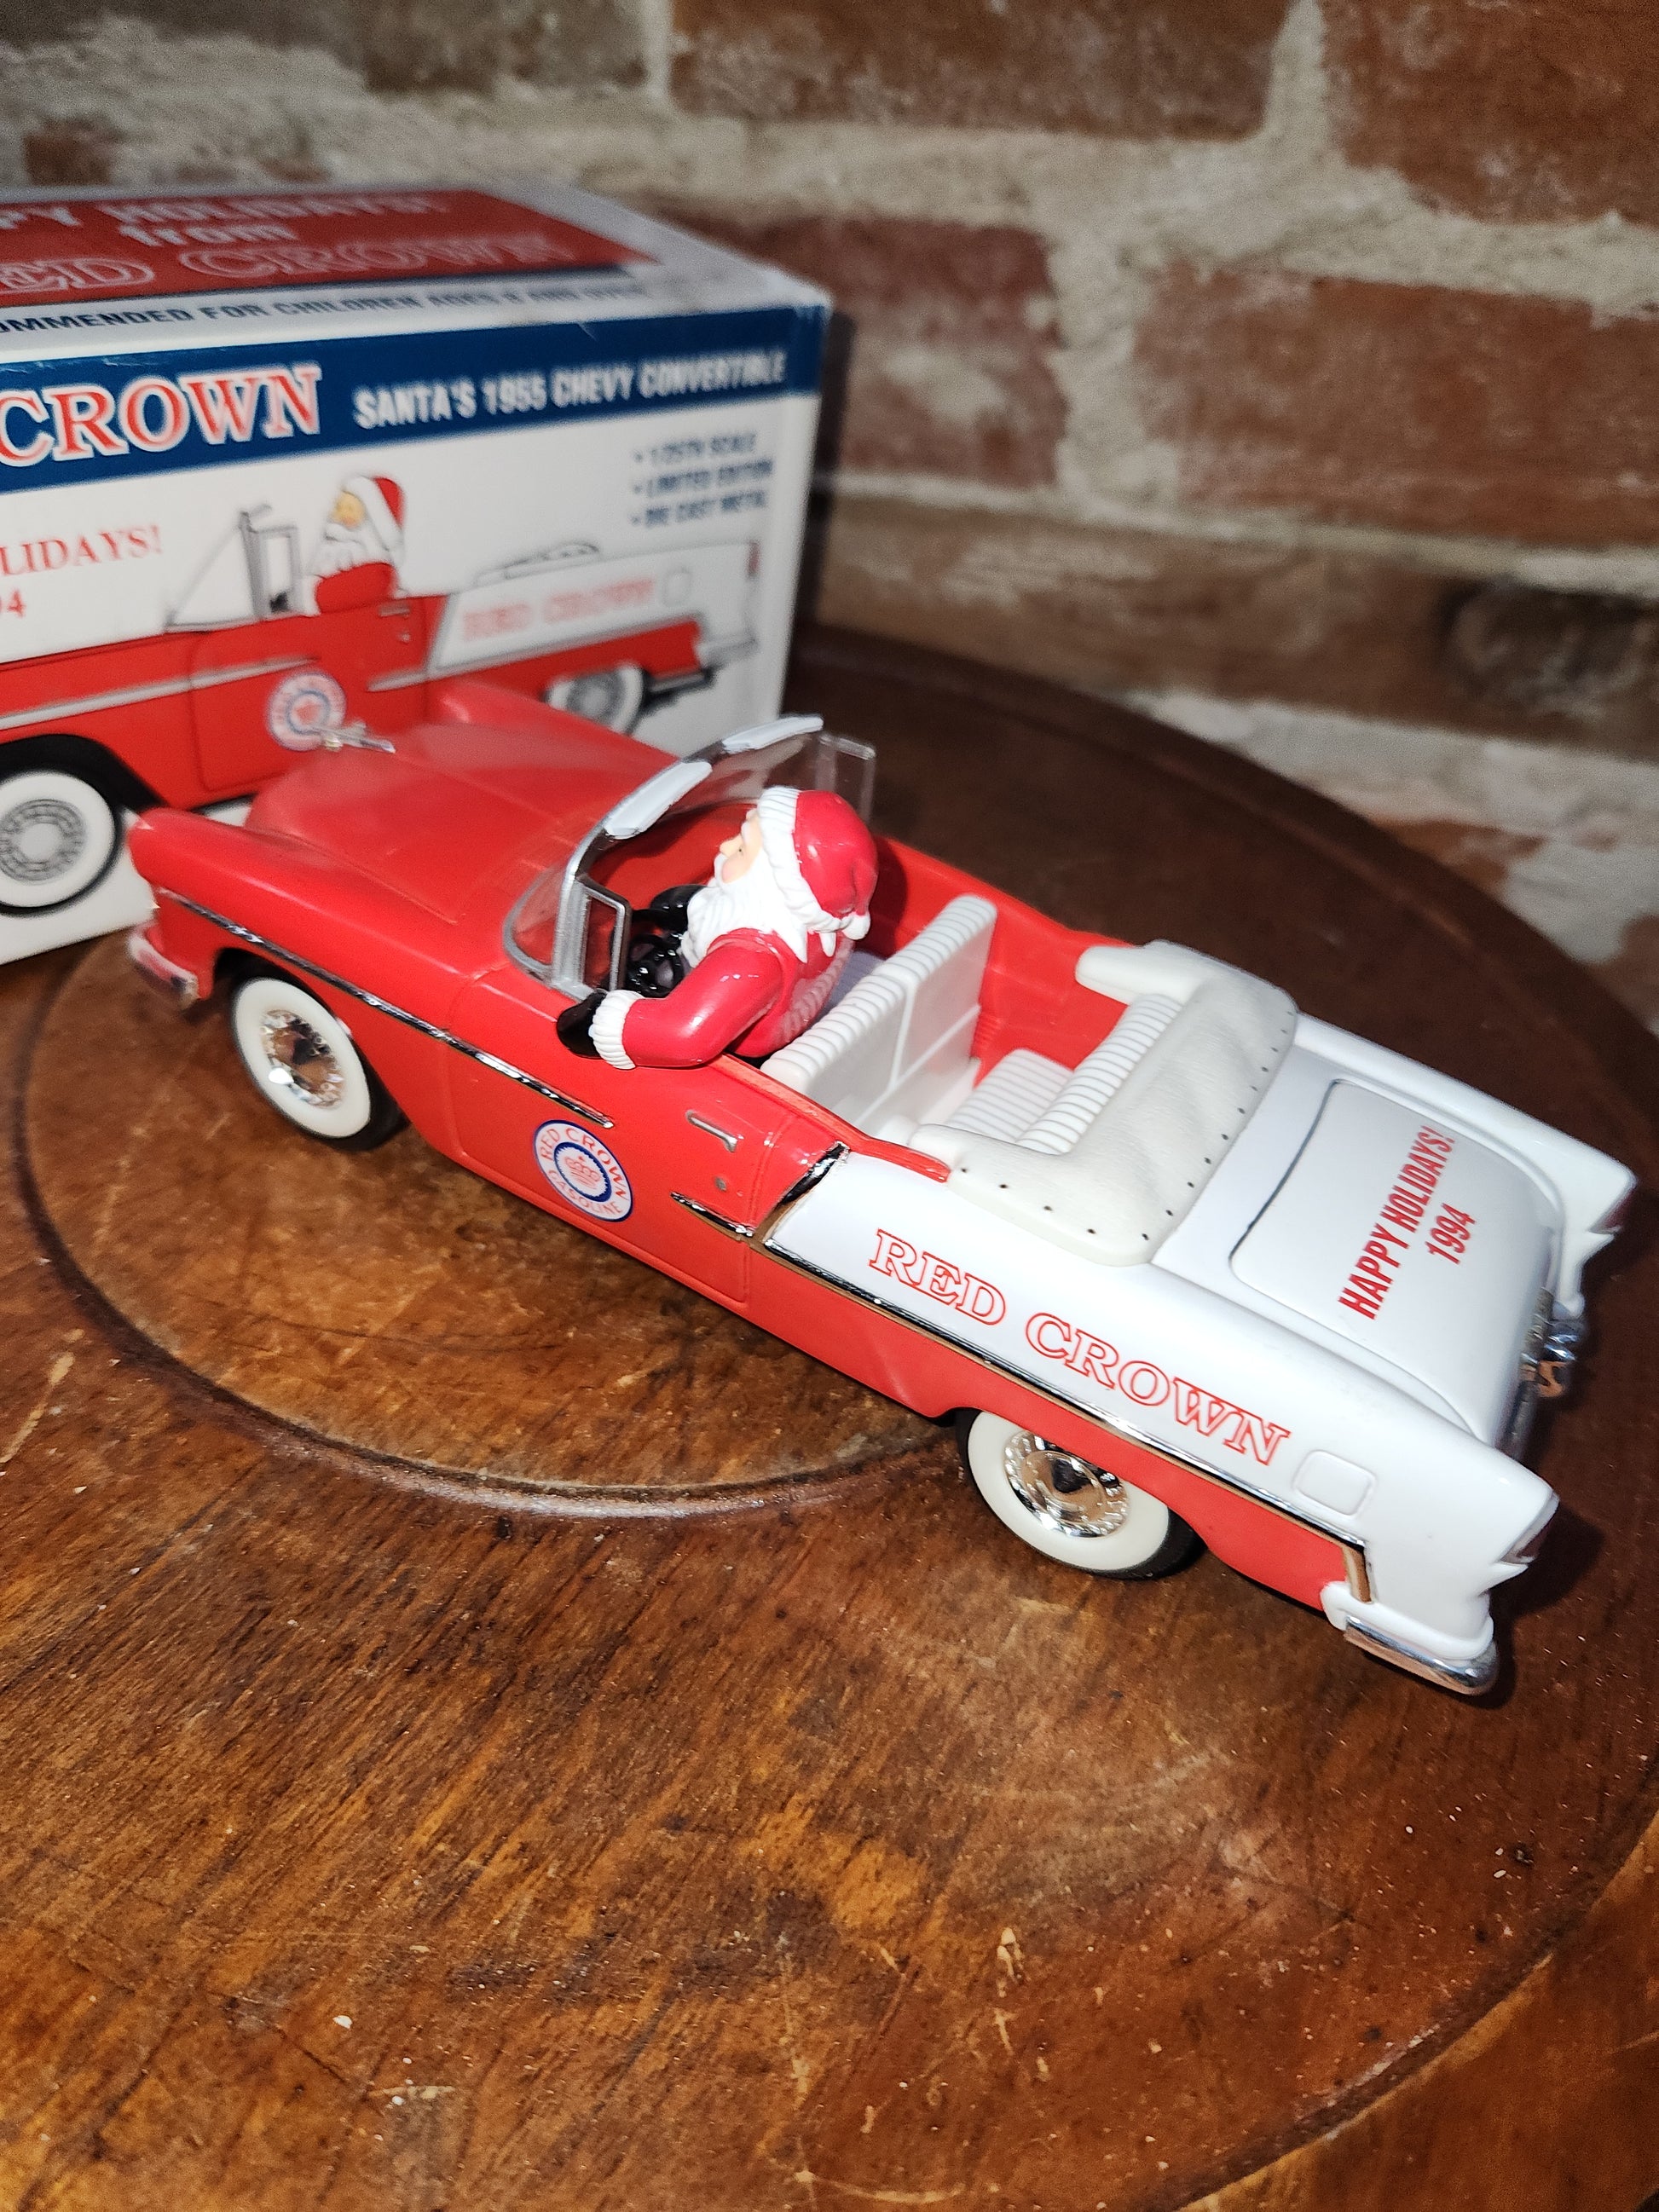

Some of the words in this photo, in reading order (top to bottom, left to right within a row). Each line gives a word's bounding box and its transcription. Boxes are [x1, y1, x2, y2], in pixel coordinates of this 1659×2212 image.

[198, 304, 270, 320] FOR
[272, 297, 425, 315] CHILDREN
[0, 361, 322, 466] CROWN
[352, 375, 477, 430] SANTA'S
[479, 367, 548, 415] 1955
[550, 360, 635, 409] CHEVY
[637, 347, 788, 399] CONVERTIBLE
[0, 524, 162, 575] LIDAYS!
[540, 1128, 562, 1162] RED
[564, 1127, 630, 1202] CROWN
[547, 1170, 622, 1216] GASOLINE
[1337, 1222, 1411, 1320] HAPPY
[1379, 1124, 1456, 1235] HOLIDAYS!
[1425, 1202, 1477, 1266] 1994
[869, 1228, 1006, 1326] RED
[1025, 1312, 1292, 1466] CROWN
